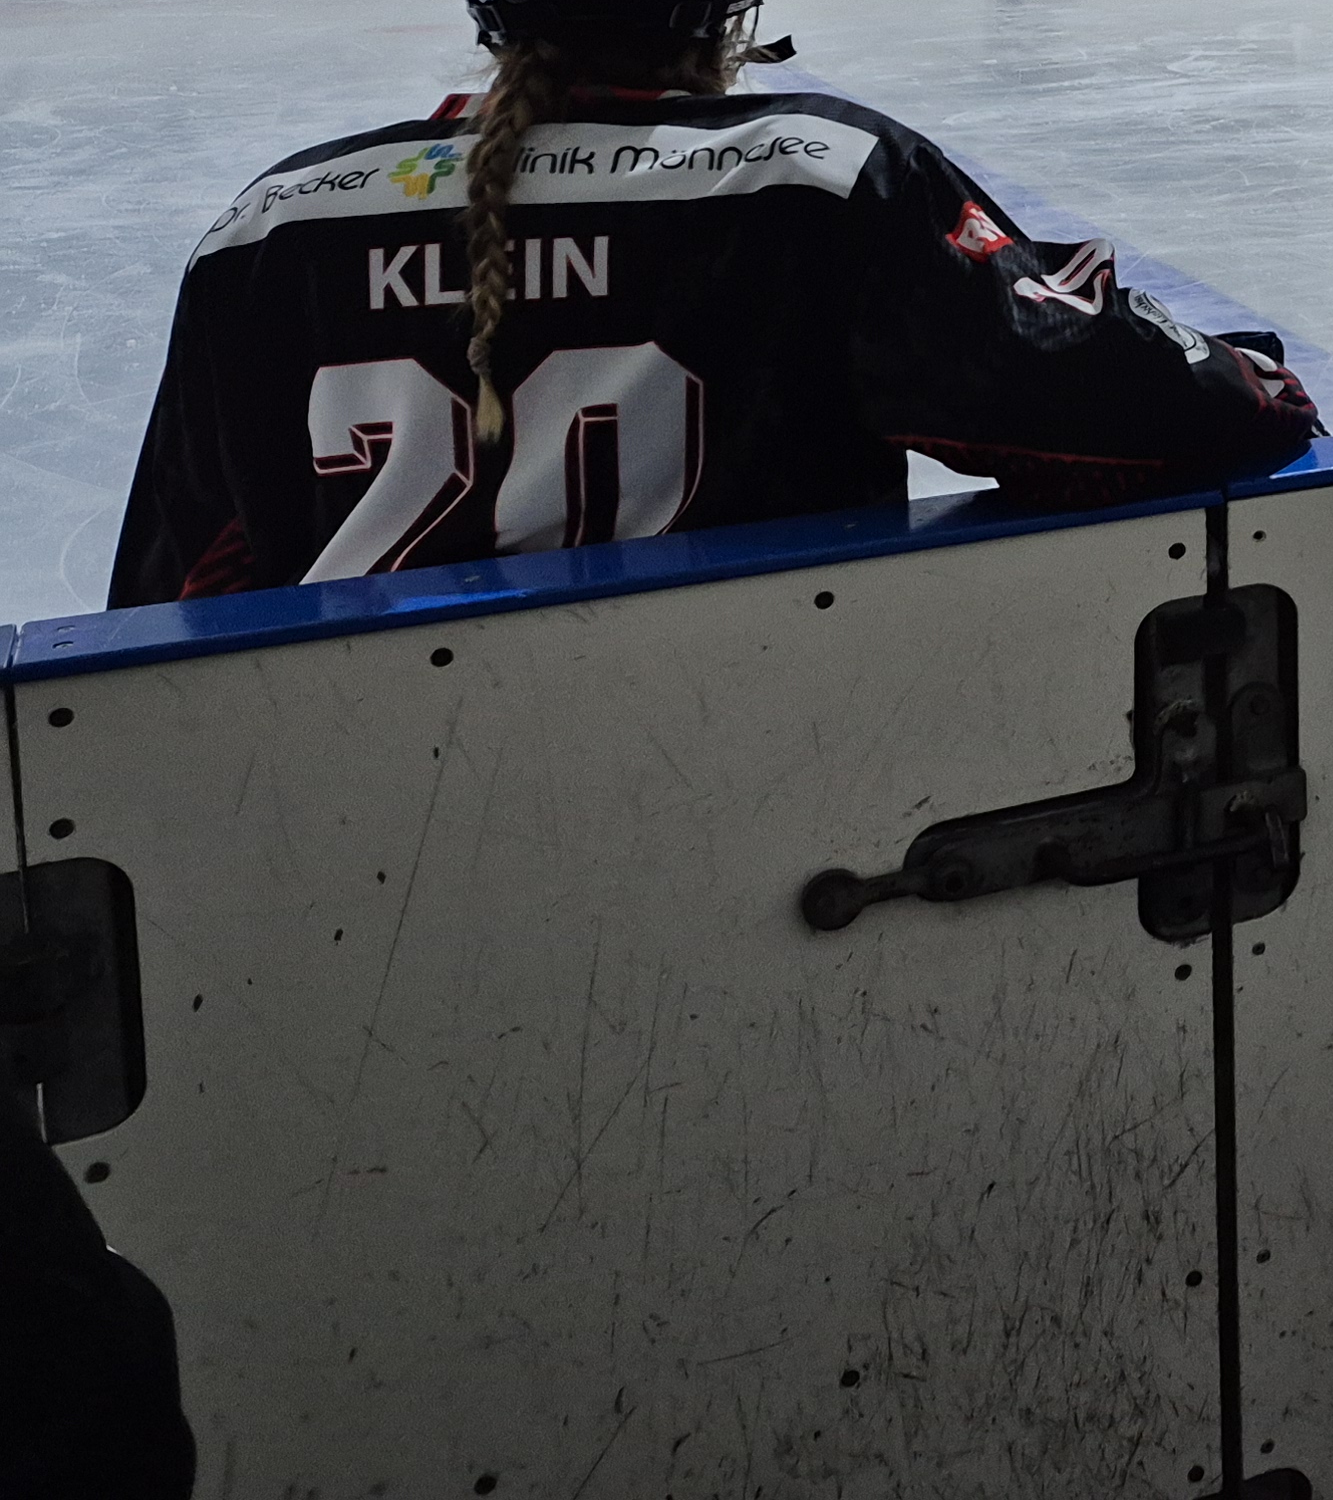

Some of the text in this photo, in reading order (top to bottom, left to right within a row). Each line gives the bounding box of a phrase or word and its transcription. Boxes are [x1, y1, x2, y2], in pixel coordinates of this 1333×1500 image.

[210, 202, 251, 233] Dr.
[261, 167, 380, 214] Becker
[511, 146, 596, 176] linik
[298, 341, 704, 585] 20
